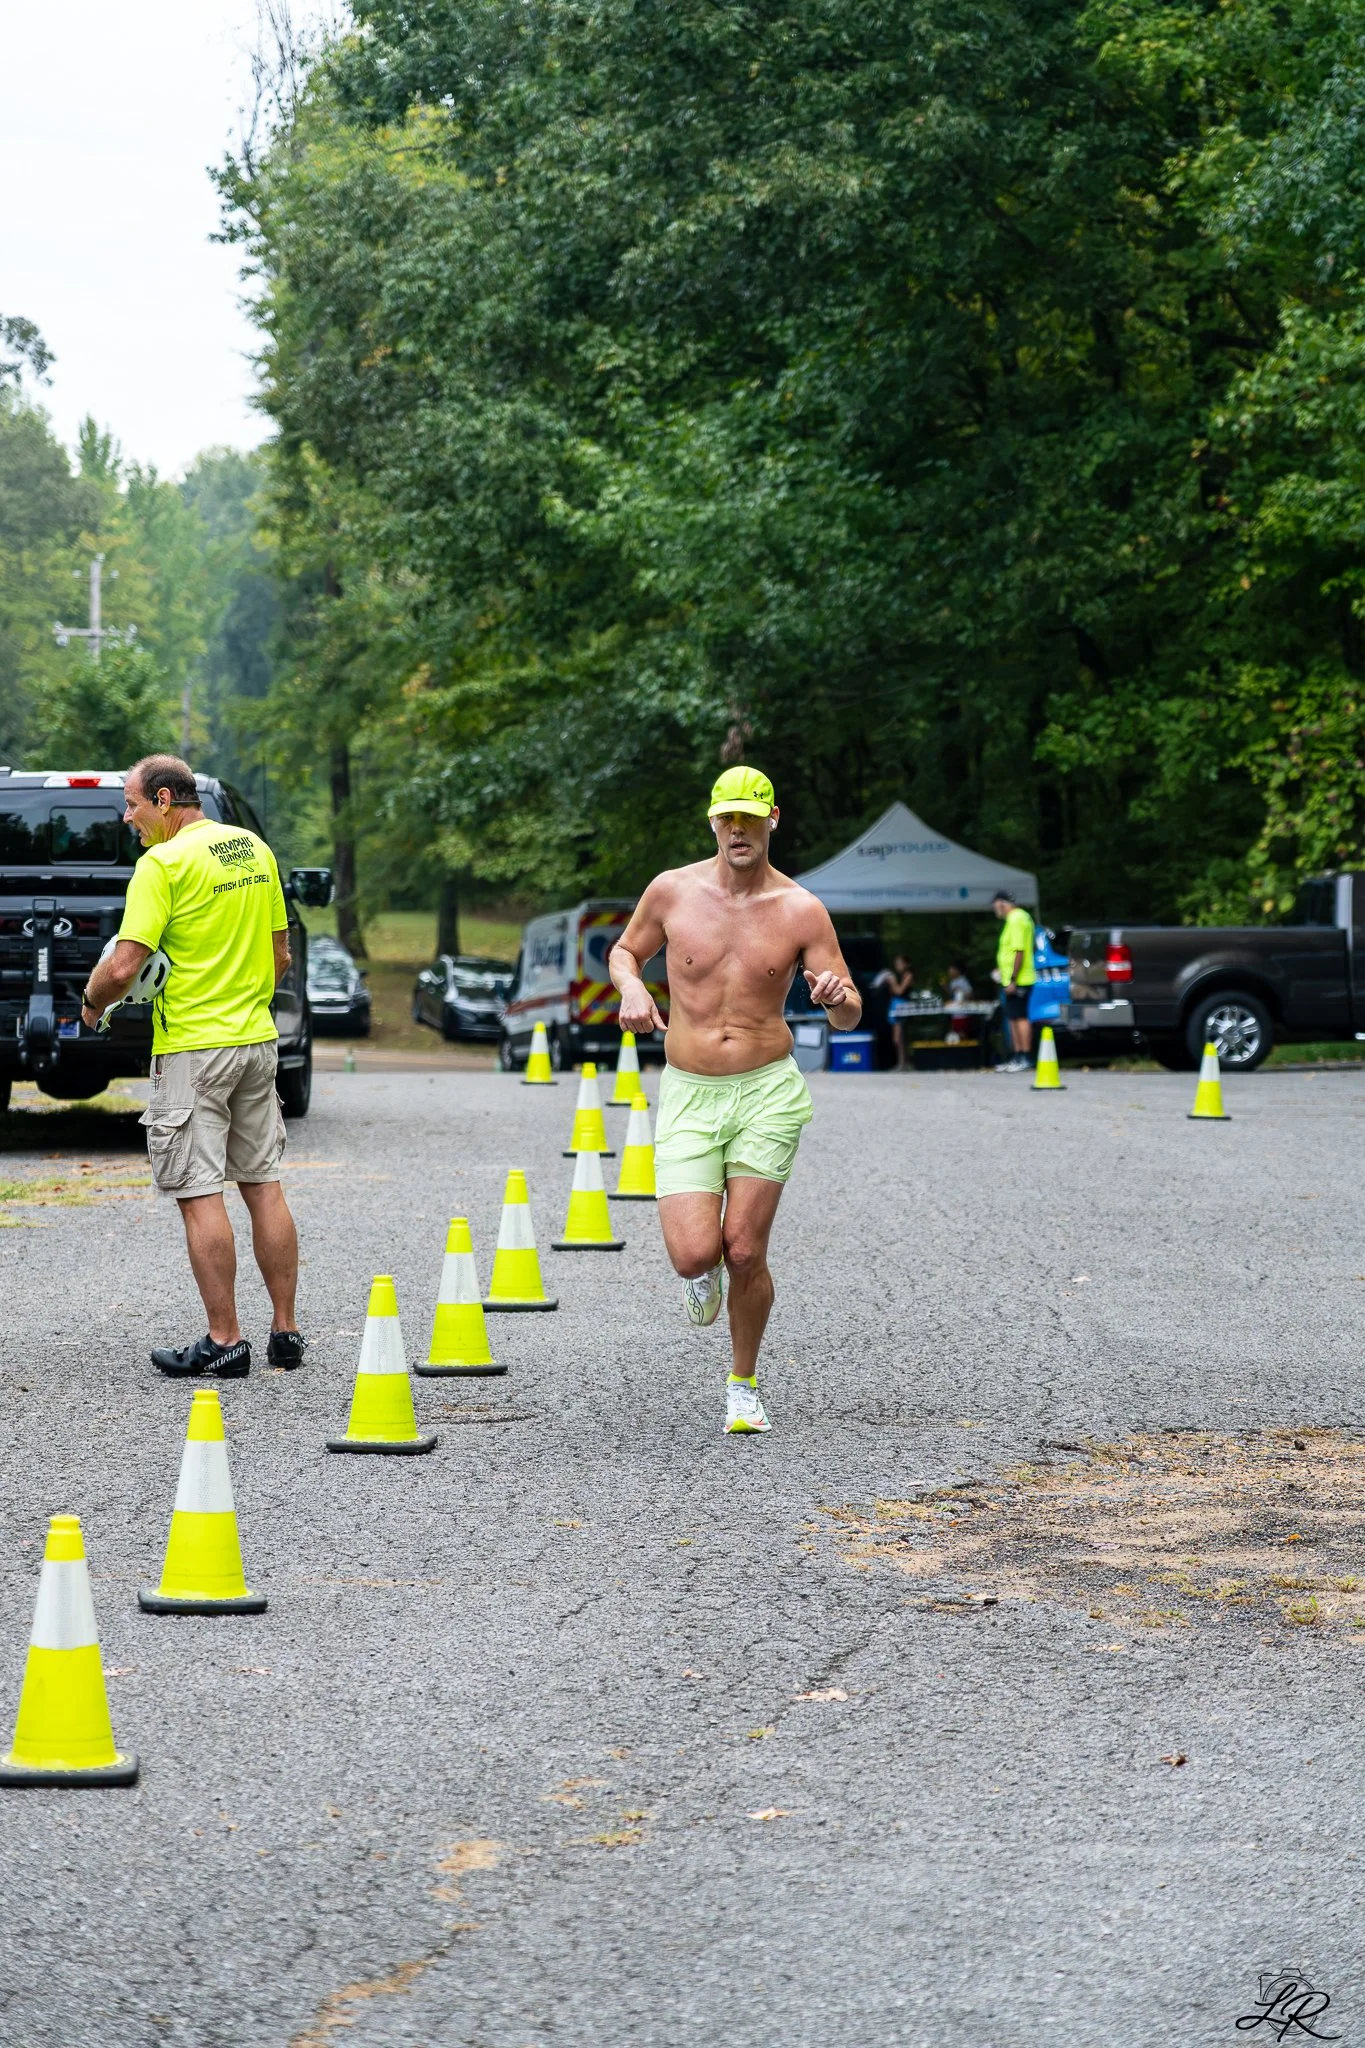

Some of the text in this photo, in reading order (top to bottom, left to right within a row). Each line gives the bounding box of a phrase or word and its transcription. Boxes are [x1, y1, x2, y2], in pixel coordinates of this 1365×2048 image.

[208, 837, 254, 857] MEMPHIS
[218, 849, 255, 865] RUNNERS
[213, 881, 237, 895] FINISH
[238, 877, 253, 888] LINE
[37, 947, 49, 982] THULE
